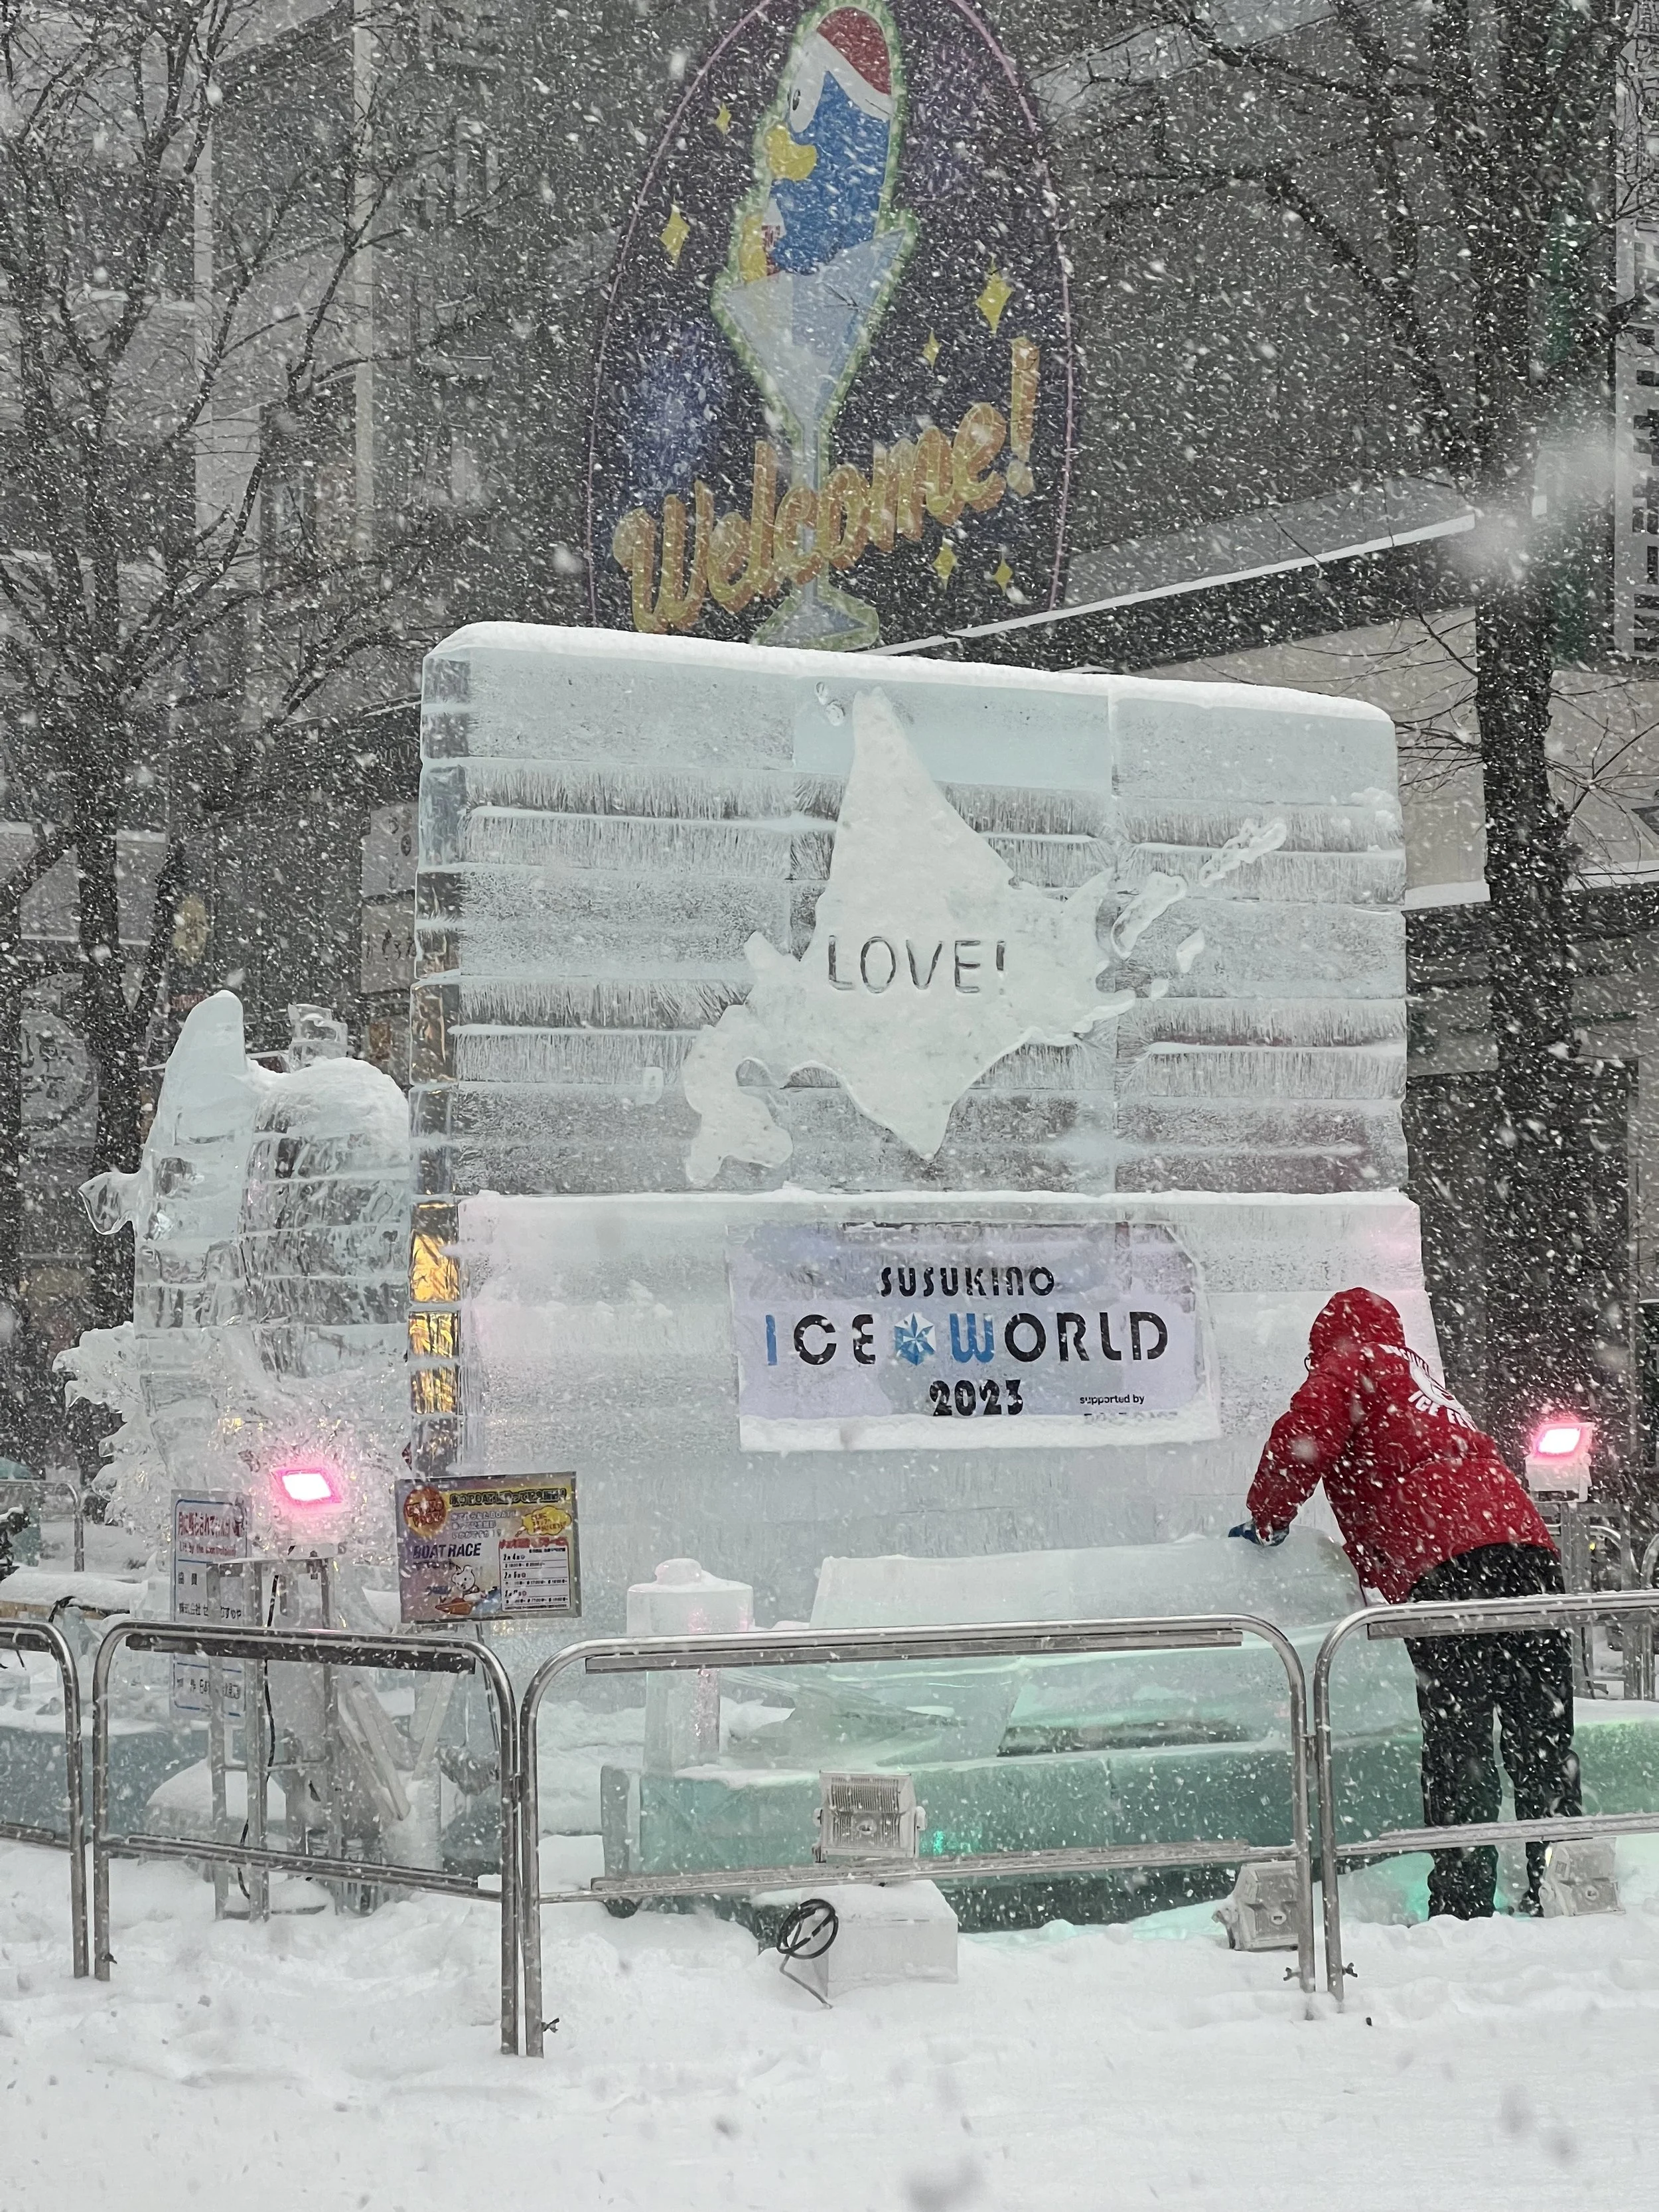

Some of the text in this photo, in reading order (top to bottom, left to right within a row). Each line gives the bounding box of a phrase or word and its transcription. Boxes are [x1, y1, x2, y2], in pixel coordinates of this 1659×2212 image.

[613, 336, 1040, 632] Welcome!
[828, 934, 1005, 994] LOVE!
[881, 1266, 1054, 1297] SUSUKINO
[765, 1311, 1168, 1365] ICE WORLD
[930, 1378, 1024, 1416] 2023
[1080, 1394, 1145, 1405] supported by
[448, 1543, 482, 1558] RACE
